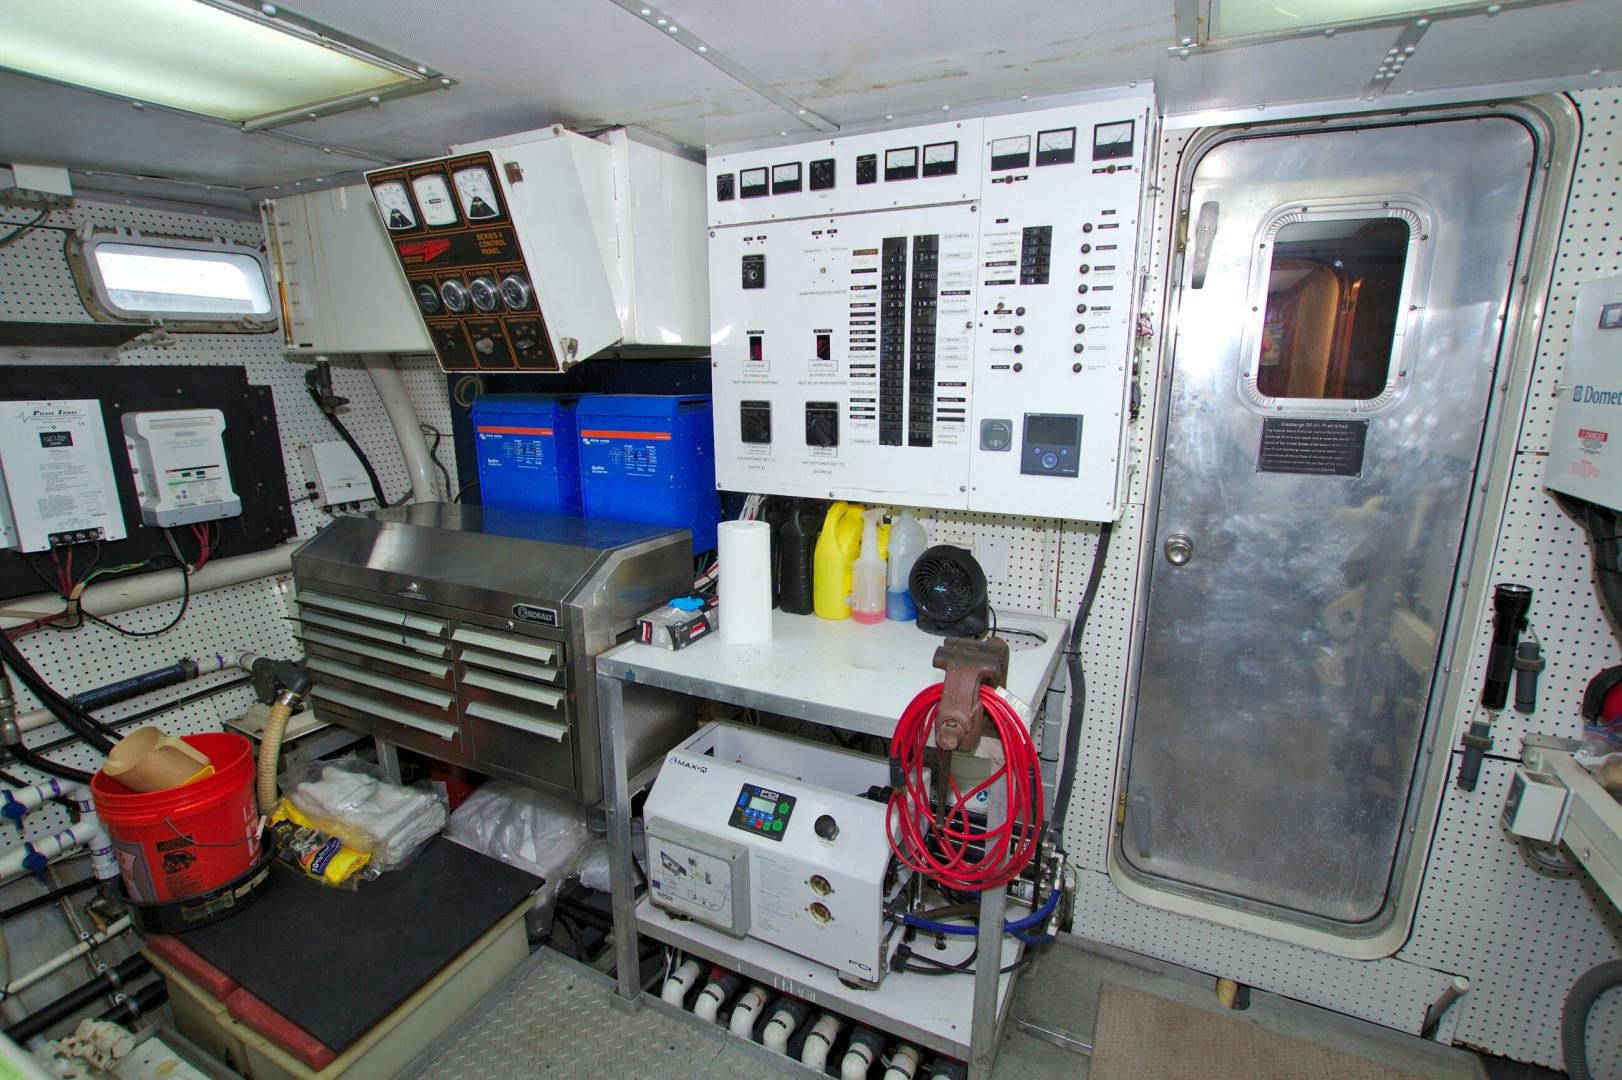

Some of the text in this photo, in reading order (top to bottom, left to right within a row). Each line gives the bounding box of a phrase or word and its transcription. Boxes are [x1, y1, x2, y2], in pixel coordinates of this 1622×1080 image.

[477, 232, 498, 240] SERIES
[479, 239, 506, 247] CONTROL
[481, 247, 502, 255] PANEL
[528, 610, 552, 621] KOBALT
